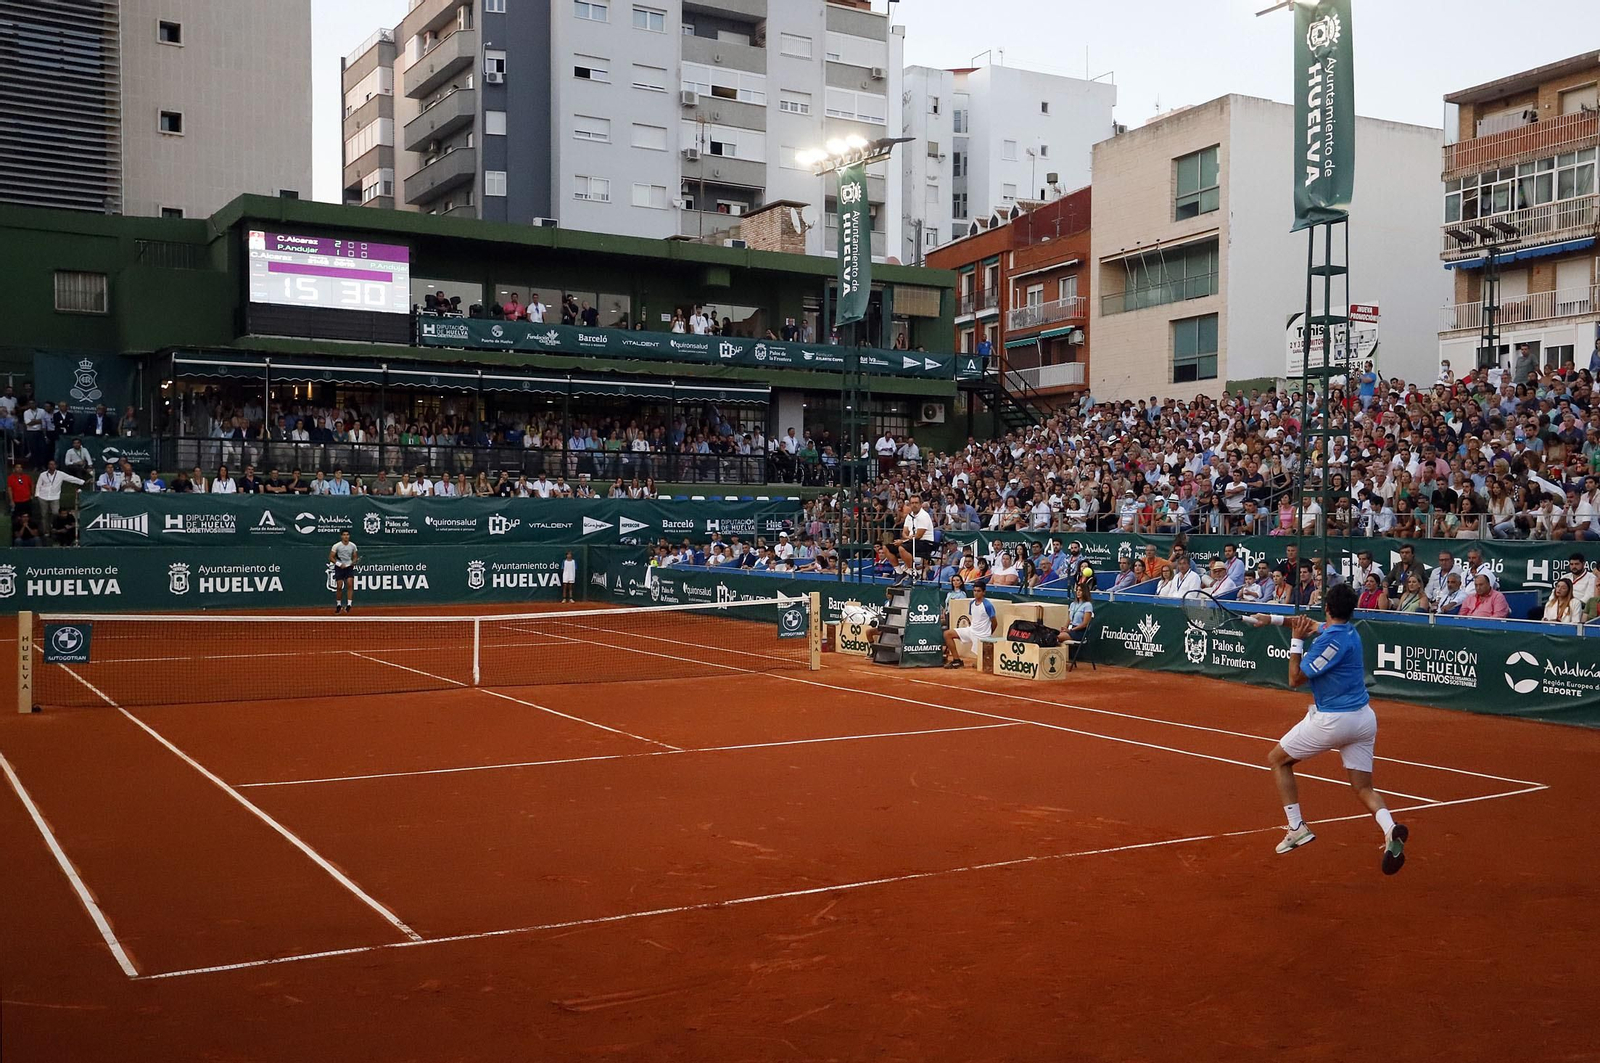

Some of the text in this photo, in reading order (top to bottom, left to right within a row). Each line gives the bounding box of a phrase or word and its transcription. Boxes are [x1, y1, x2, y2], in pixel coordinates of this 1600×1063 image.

[1324, 57, 1337, 177] Ayuntamiento de
[1305, 63, 1322, 187] HUELVA
[277, 235, 319, 246] C.Alcaraz
[334, 240, 342, 248] 2
[277, 244, 319, 254] P.Andujar
[843, 213, 851, 297] HUELVA
[851, 210, 861, 292] Ayuntamiento de
[250, 251, 293, 261] C.Alcaraz
[285, 277, 386, 305] 15 30
[578, 333, 608, 343] Barceló
[185, 512, 236, 521] DIPUTACIÓN
[318, 514, 353, 523] Andalucía
[662, 519, 694, 528] Barceló
[1085, 543, 1111, 554] Andalucía
[26, 565, 118, 578] Ayuntamiento de
[198, 563, 281, 576] Ayuntamiento de
[353, 561, 427, 573] Ayuntamiento de
[491, 561, 560, 571] Ayuntamiento de
[27, 578, 122, 596] HUELVA
[199, 576, 284, 593] HUELVA
[353, 574, 429, 590] HUELVA
[492, 573, 561, 588] HUELVA
[909, 611, 940, 624] Seabery
[1100, 625, 1144, 643] Fundación
[1212, 627, 1244, 637] Ayuntamiento
[903, 644, 942, 652] SOLDAMATIC
[1124, 641, 1165, 653] CAJA RURAL
[1212, 639, 1245, 653] Palos de
[1212, 653, 1256, 669] la Frontera
[1406, 646, 1478, 665] DIPUTACIÓN
[1000, 653, 1039, 679] Seabery
[1406, 659, 1477, 678] DE HUELVA
[1543, 658, 1600, 678] Andalucía
[1406, 671, 1450, 685] OBJETIVOS
[1543, 679, 1565, 687] Región
[1566, 681, 1594, 691] Europea
[1543, 686, 1582, 697] DEPORTE
